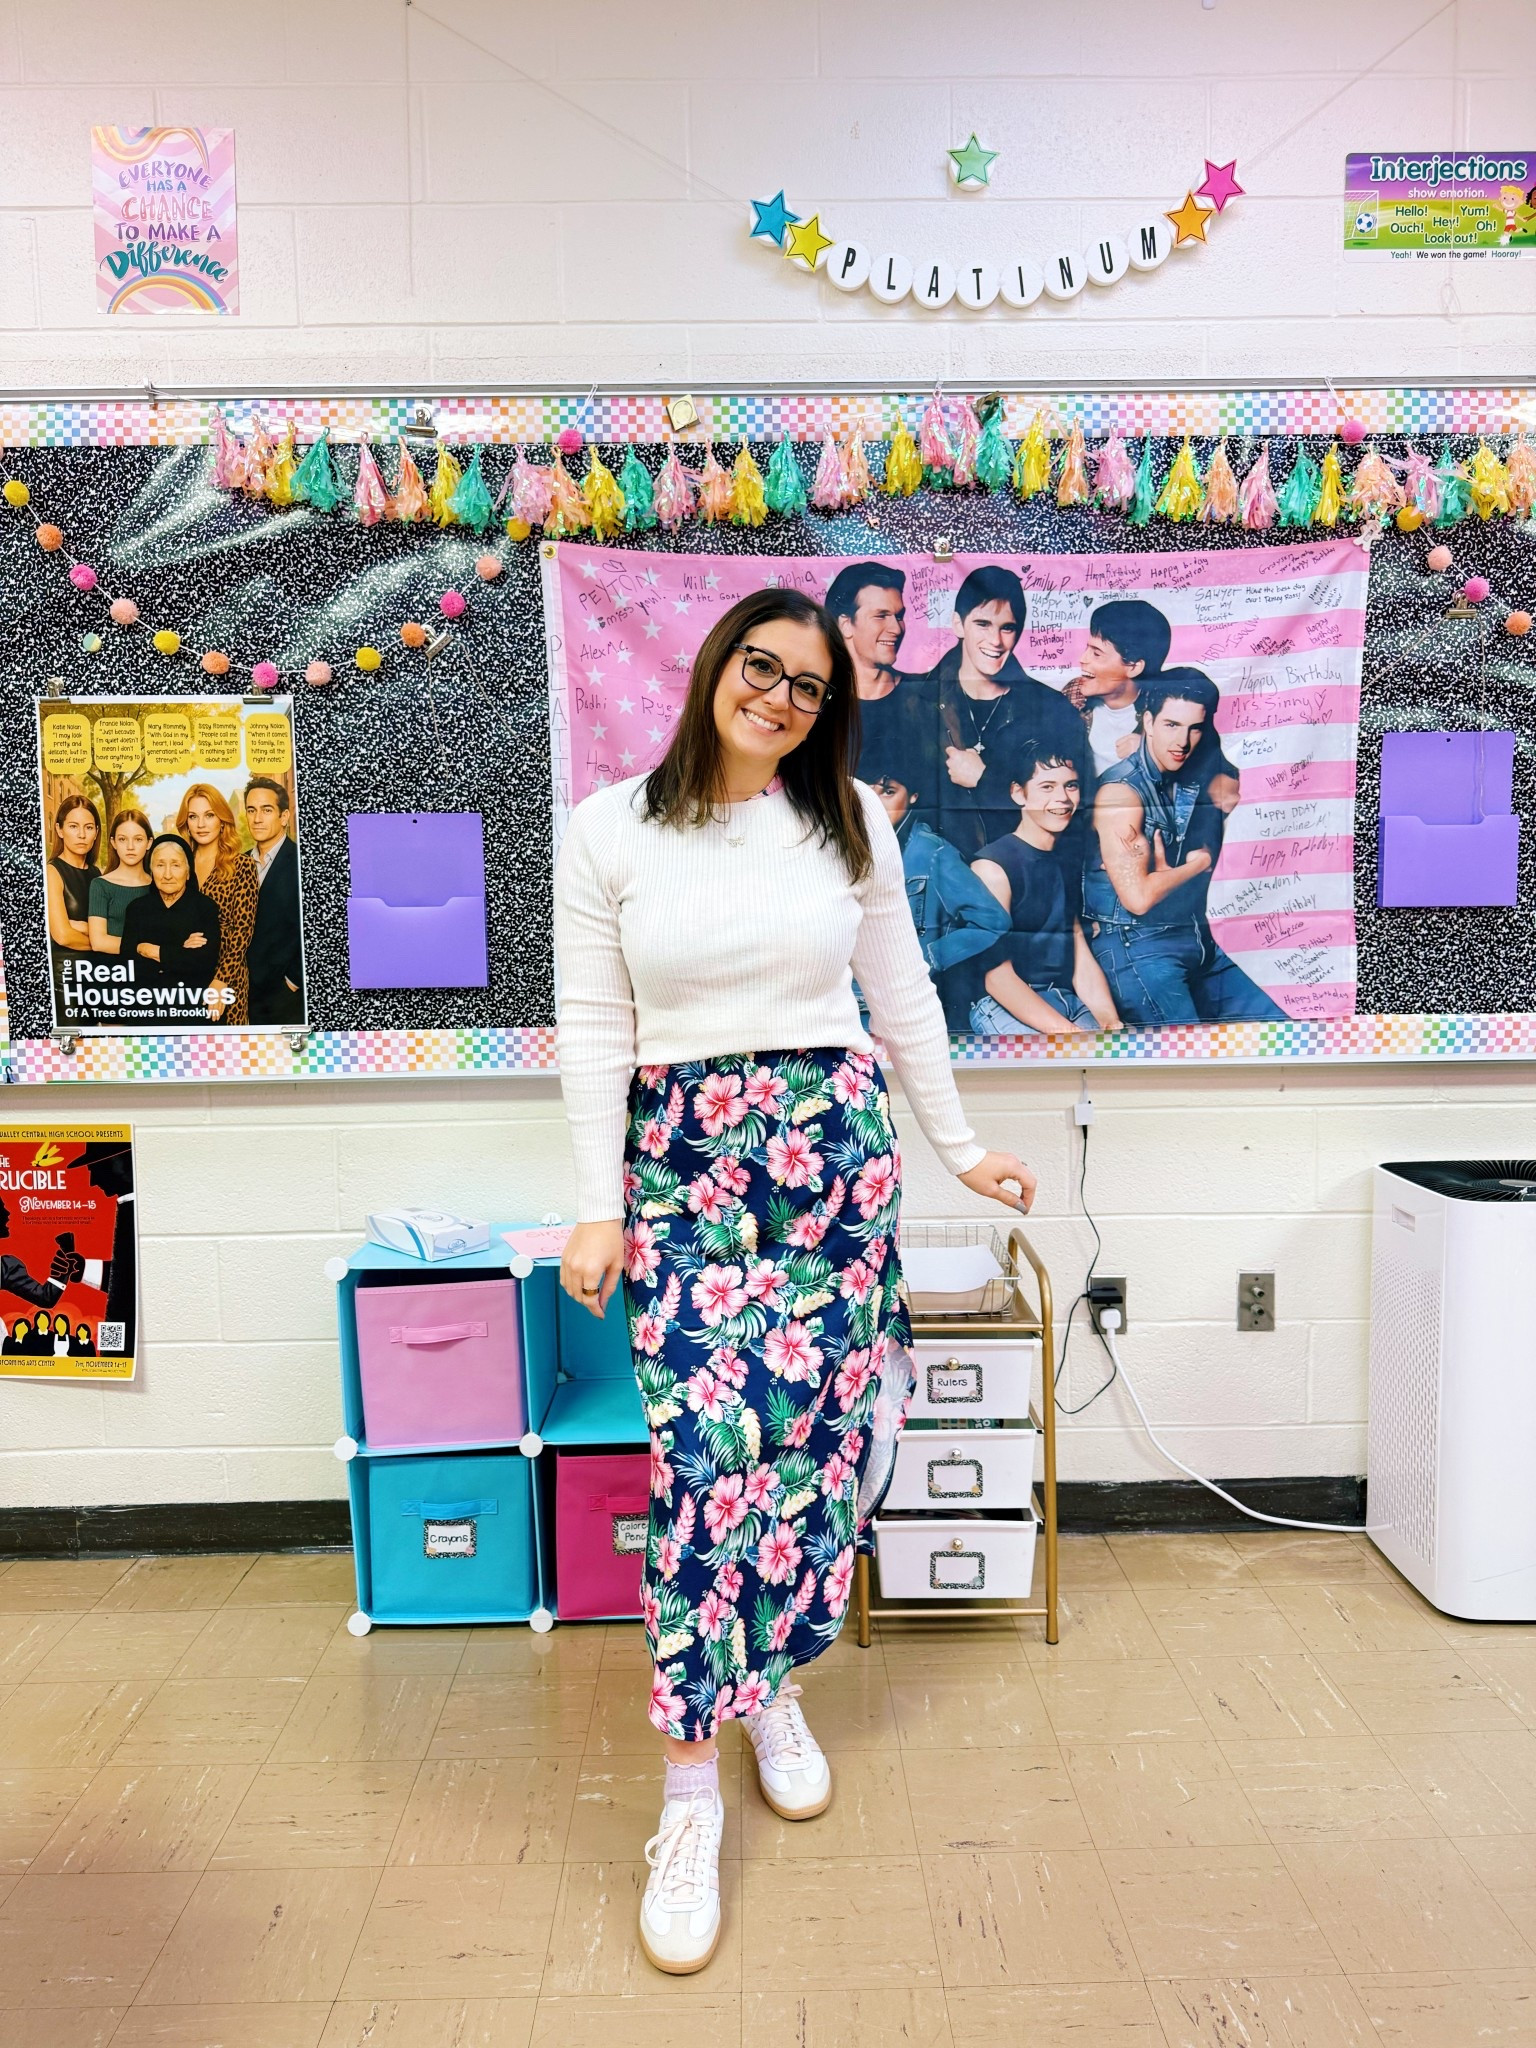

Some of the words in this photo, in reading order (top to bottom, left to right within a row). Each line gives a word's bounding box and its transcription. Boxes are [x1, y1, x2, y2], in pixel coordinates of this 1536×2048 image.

[119, 160, 213, 189] EVERYONE
[1371, 156, 1526, 186] Interjections
[147, 179, 173, 192] HAS
[177, 181, 187, 191] A
[1408, 187, 1437, 198] show
[1440, 188, 1488, 198] emotion.
[121, 193, 213, 222] CHANCE
[1395, 206, 1428, 217] Hello!
[1460, 206, 1489, 216] Yum!
[1390, 222, 1424, 233] Ouch!
[1476, 220, 1497, 231] Oh!
[1433, 217, 1459, 229] Hey!
[114, 222, 139, 240] TO
[148, 222, 200, 241] MAKE
[206, 225, 221, 241] A
[1425, 233, 1452, 244] Look
[1454, 233, 1477, 243] out!
[100, 241, 229, 282] Difference
[841, 226, 1158, 300] PLATINUM
[1391, 251, 1412, 259] Yeah!
[1416, 251, 1429, 259] We
[1463, 251, 1487, 260] game!
[1491, 250, 1522, 260] Hooray!
[1150, 565, 1179, 579] Happy
[578, 568, 653, 611] PEYTON
[1024, 571, 1057, 600] Emily
[1060, 576, 1071, 595] P
[697, 593, 713, 602] the
[1031, 593, 1062, 609] HAPPY
[1031, 620, 1062, 635] Happy
[580, 643, 607, 662] Alex
[660, 657, 691, 673] Sofia
[1238, 665, 1278, 699] Happy
[1286, 657, 1343, 688] Birthday
[641, 696, 672, 716] Rye
[1235, 715, 1257, 729] Lots
[251, 748, 268, 756] hitting
[586, 750, 632, 786] Happ
[1250, 844, 1286, 872] Happy
[62, 959, 72, 983] The
[75, 959, 135, 982] Real
[64, 982, 236, 1006] Housewives
[1284, 995, 1311, 1005] Happy
[1312, 988, 1349, 1001] Birthday
[65, 1007, 79, 1018] Of
[81, 1008, 90, 1017] A
[91, 1007, 117, 1018] Tree
[118, 1007, 154, 1018] Grows
[156, 1007, 167, 1017] In
[170, 1007, 220, 1019] Brooklyn
[96, 1130, 123, 1138] PRESENTS
[19, 1196, 71, 1213] NOVEMBER
[86, 1360, 113, 1368] NOVEMBER
[937, 1377, 968, 1387] Rulers
[620, 1522, 649, 1531] Colore
[429, 1534, 469, 1544] Crayons
